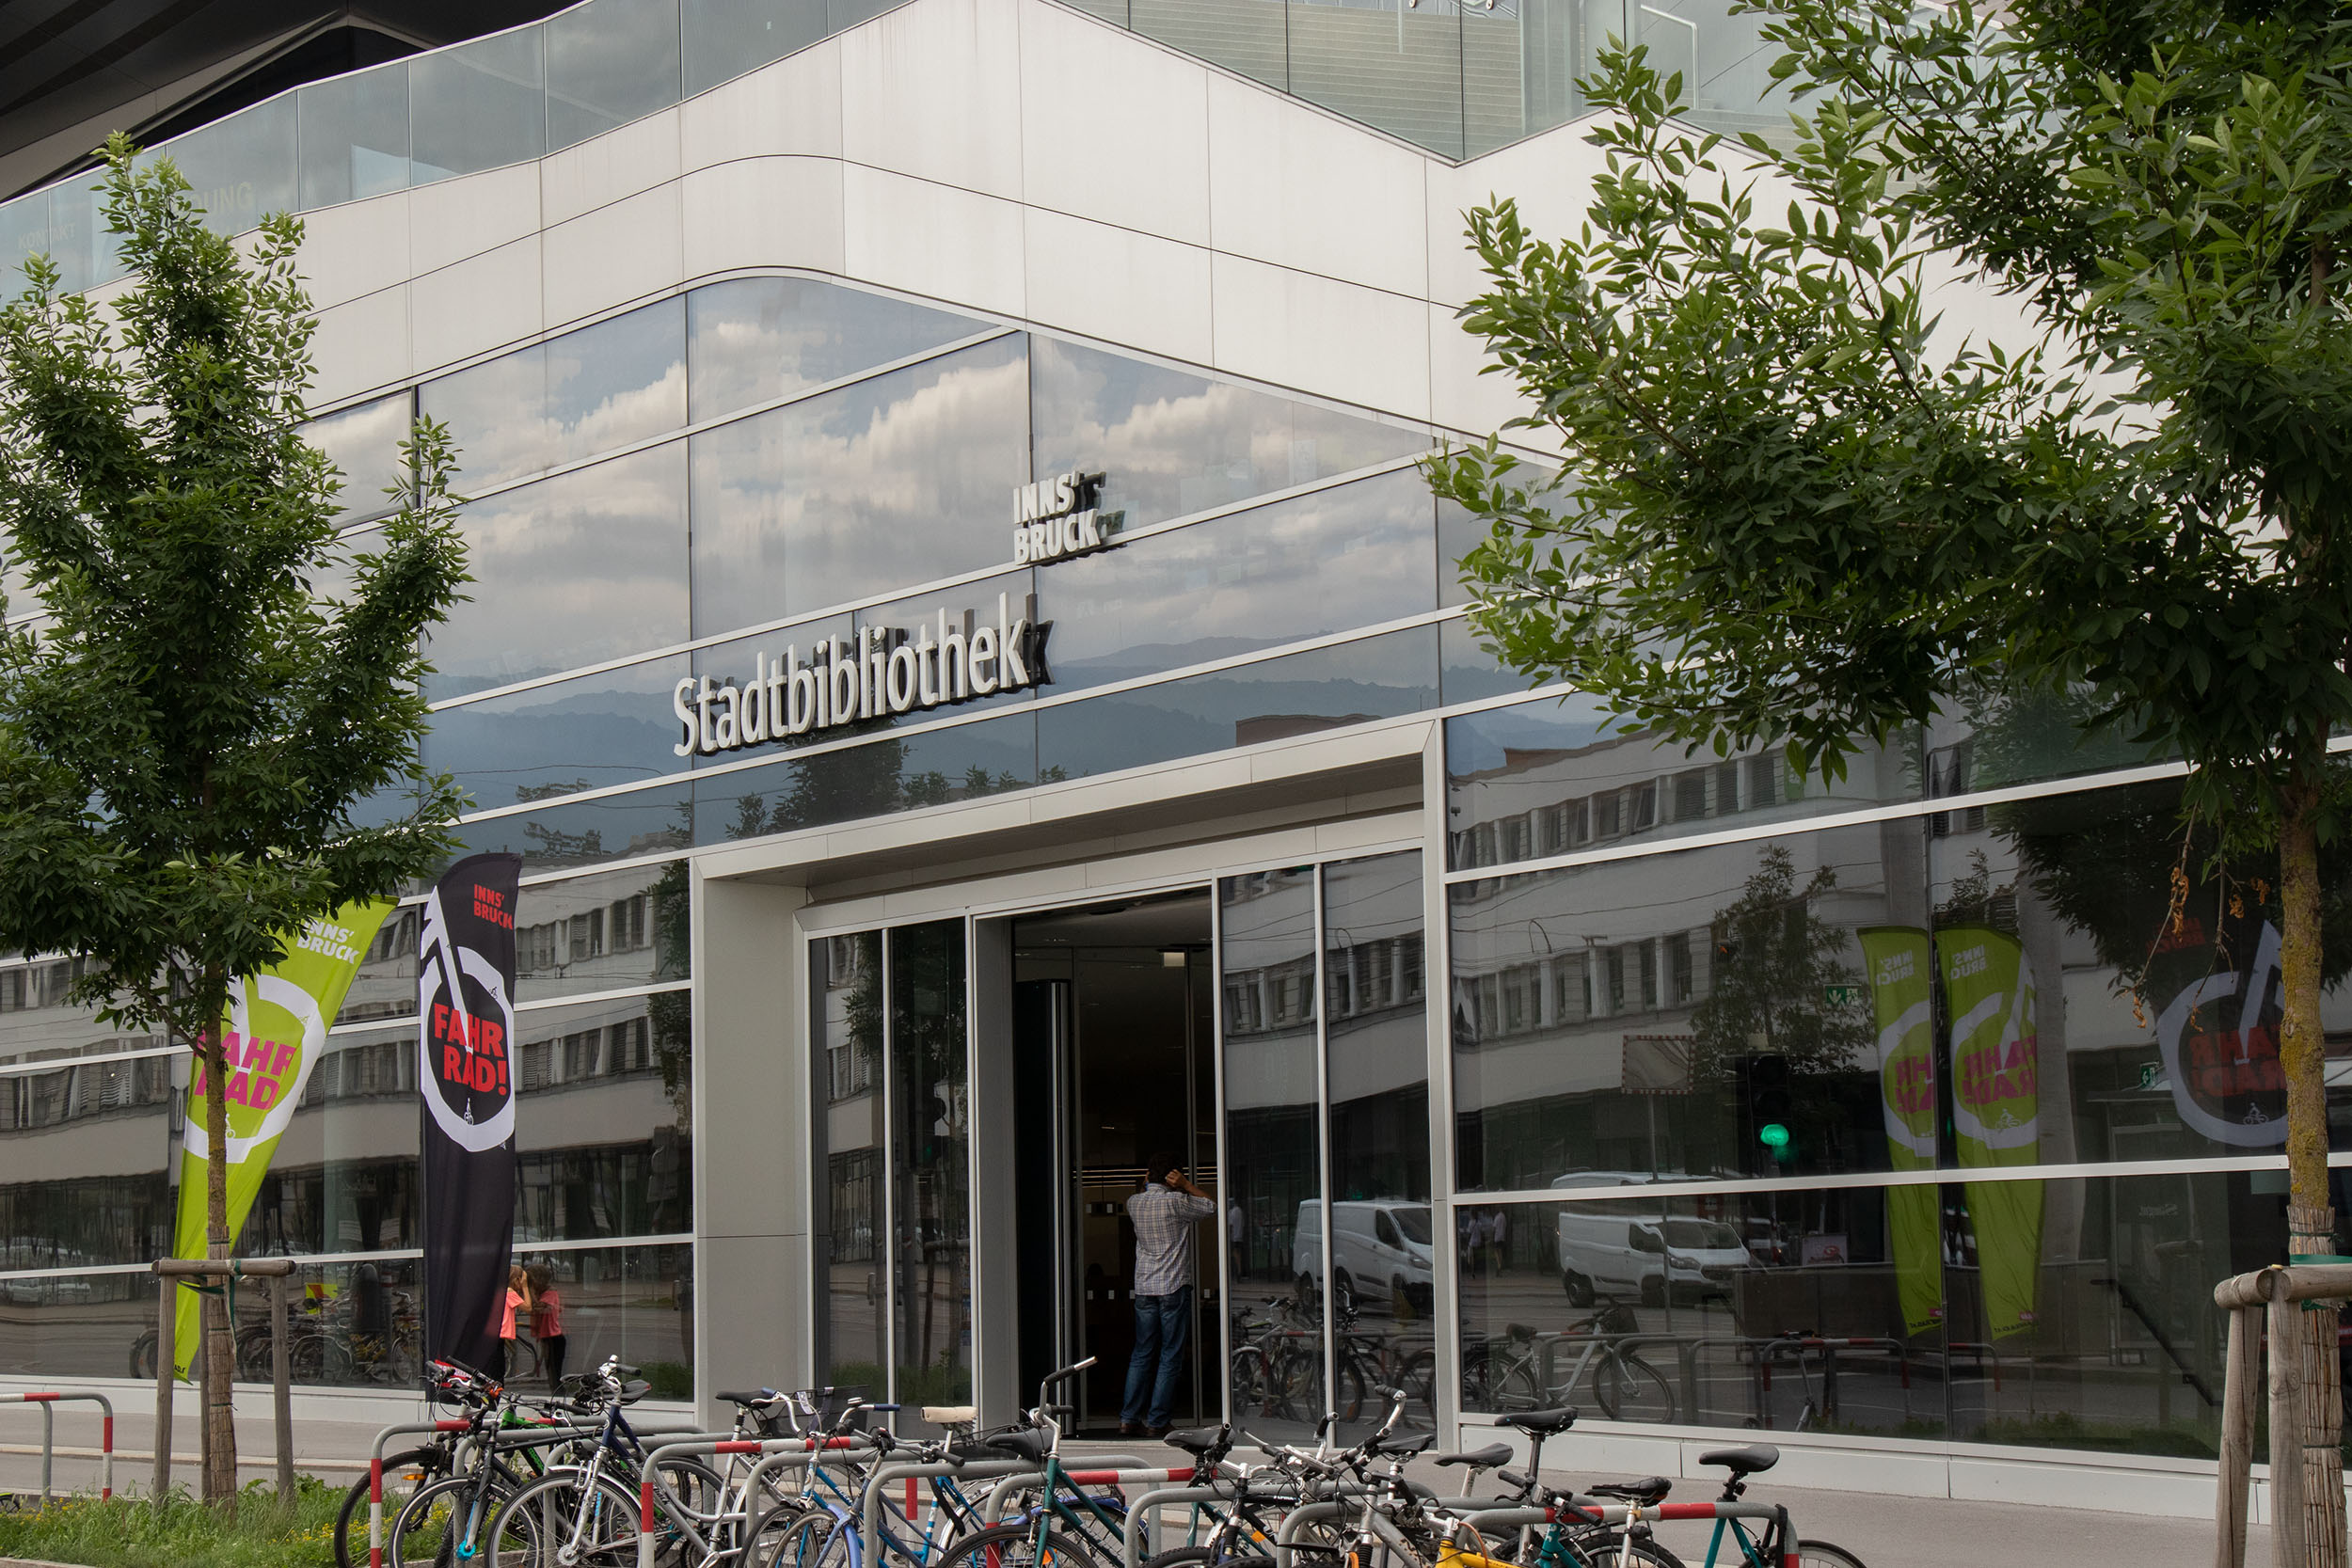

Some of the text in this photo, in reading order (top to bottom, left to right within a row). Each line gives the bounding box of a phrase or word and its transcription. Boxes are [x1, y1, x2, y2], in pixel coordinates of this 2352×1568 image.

[1014, 508, 1101, 565] BRUCK
[673, 592, 1029, 756] Stadtbibliothek
[474, 900, 514, 930] BRUCK
[296, 935, 360, 964] BRUCK
[435, 1002, 505, 1058] FAHR
[443, 1044, 507, 1097] RAD!
